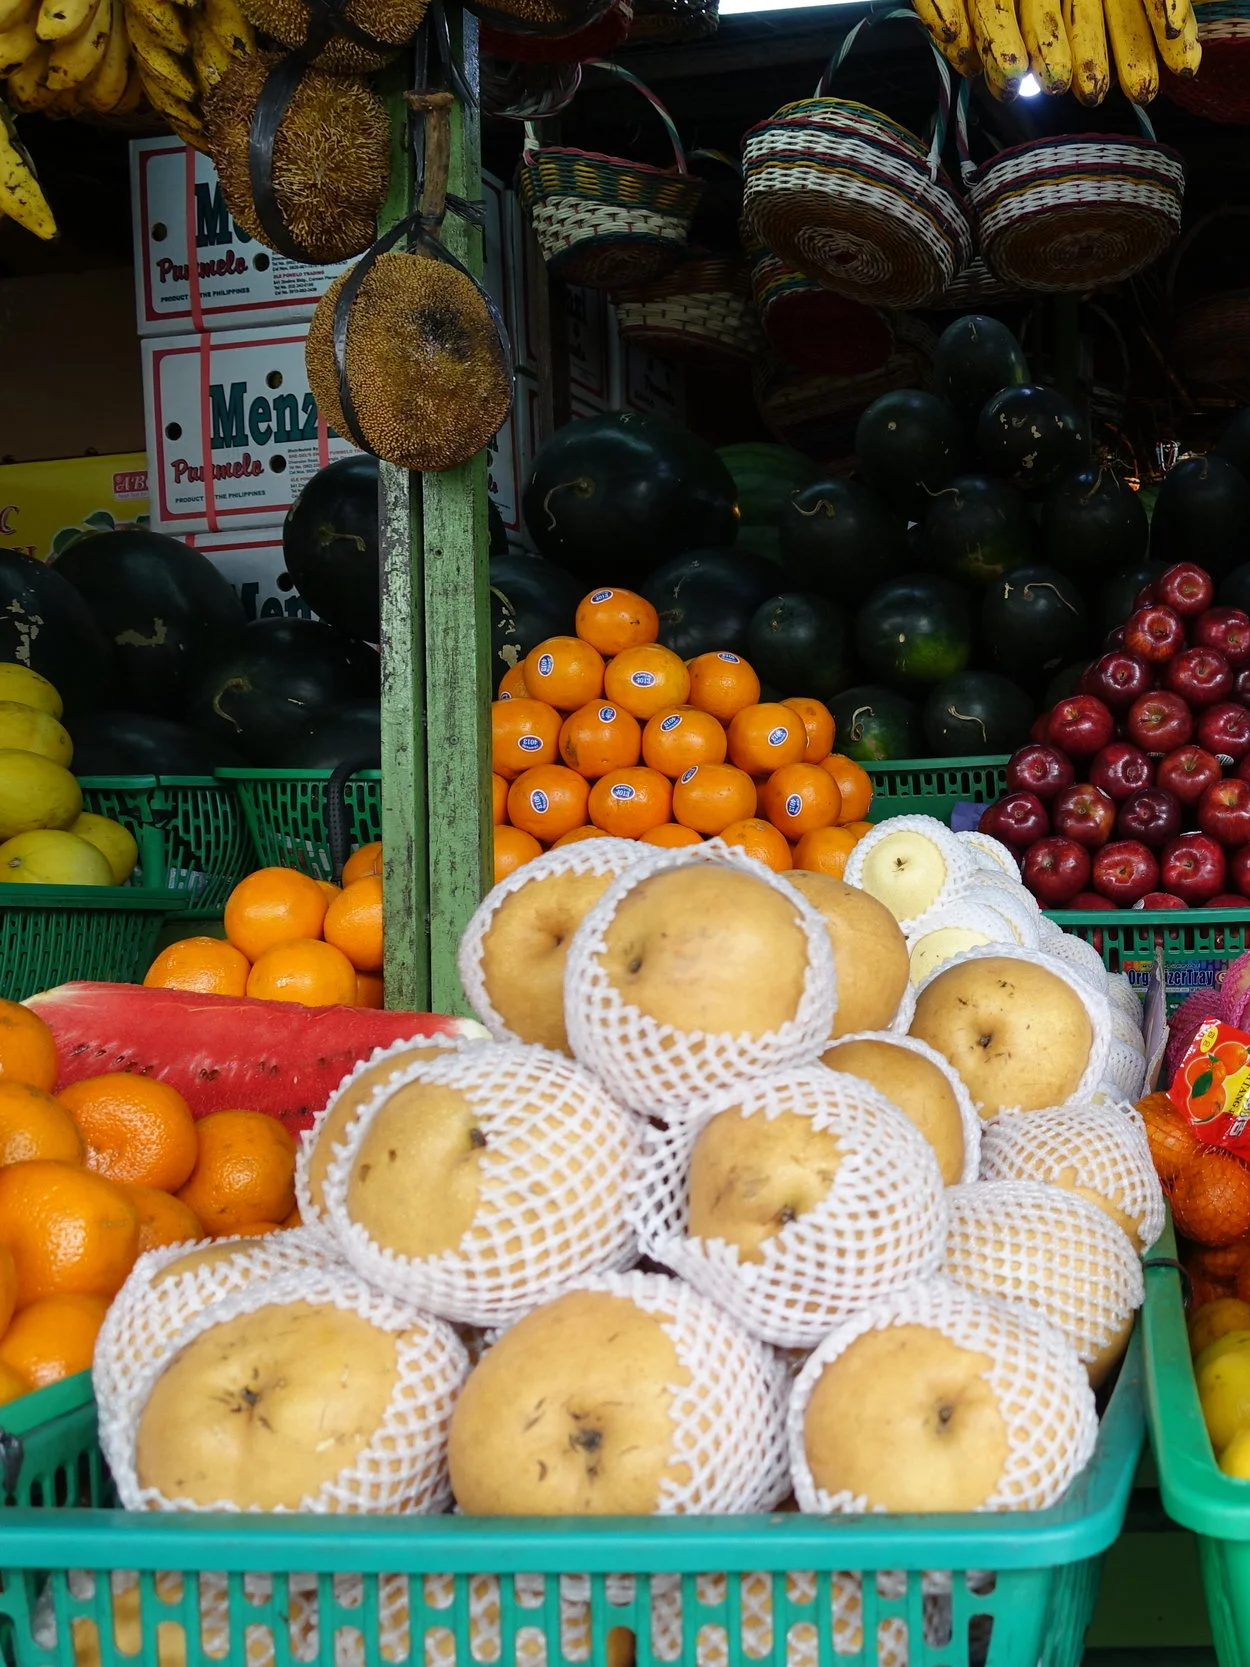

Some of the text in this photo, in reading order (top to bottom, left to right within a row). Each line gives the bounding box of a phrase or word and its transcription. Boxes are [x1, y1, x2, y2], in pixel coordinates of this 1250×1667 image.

[160, 294, 189, 302] PRODUCT
[213, 287, 250, 297] PHILIPPINES
[209, 381, 343, 450] Menz
[175, 495, 204, 503] PRODUCT
[228, 490, 265, 498] PHILIPPINES
[539, 659, 547, 672] 4013
[664, 717, 676, 727] 4013
[533, 795, 542, 809] 4013
[788, 798, 796, 812] 4013
[1128, 968, 1214, 987] OrgizerTray
